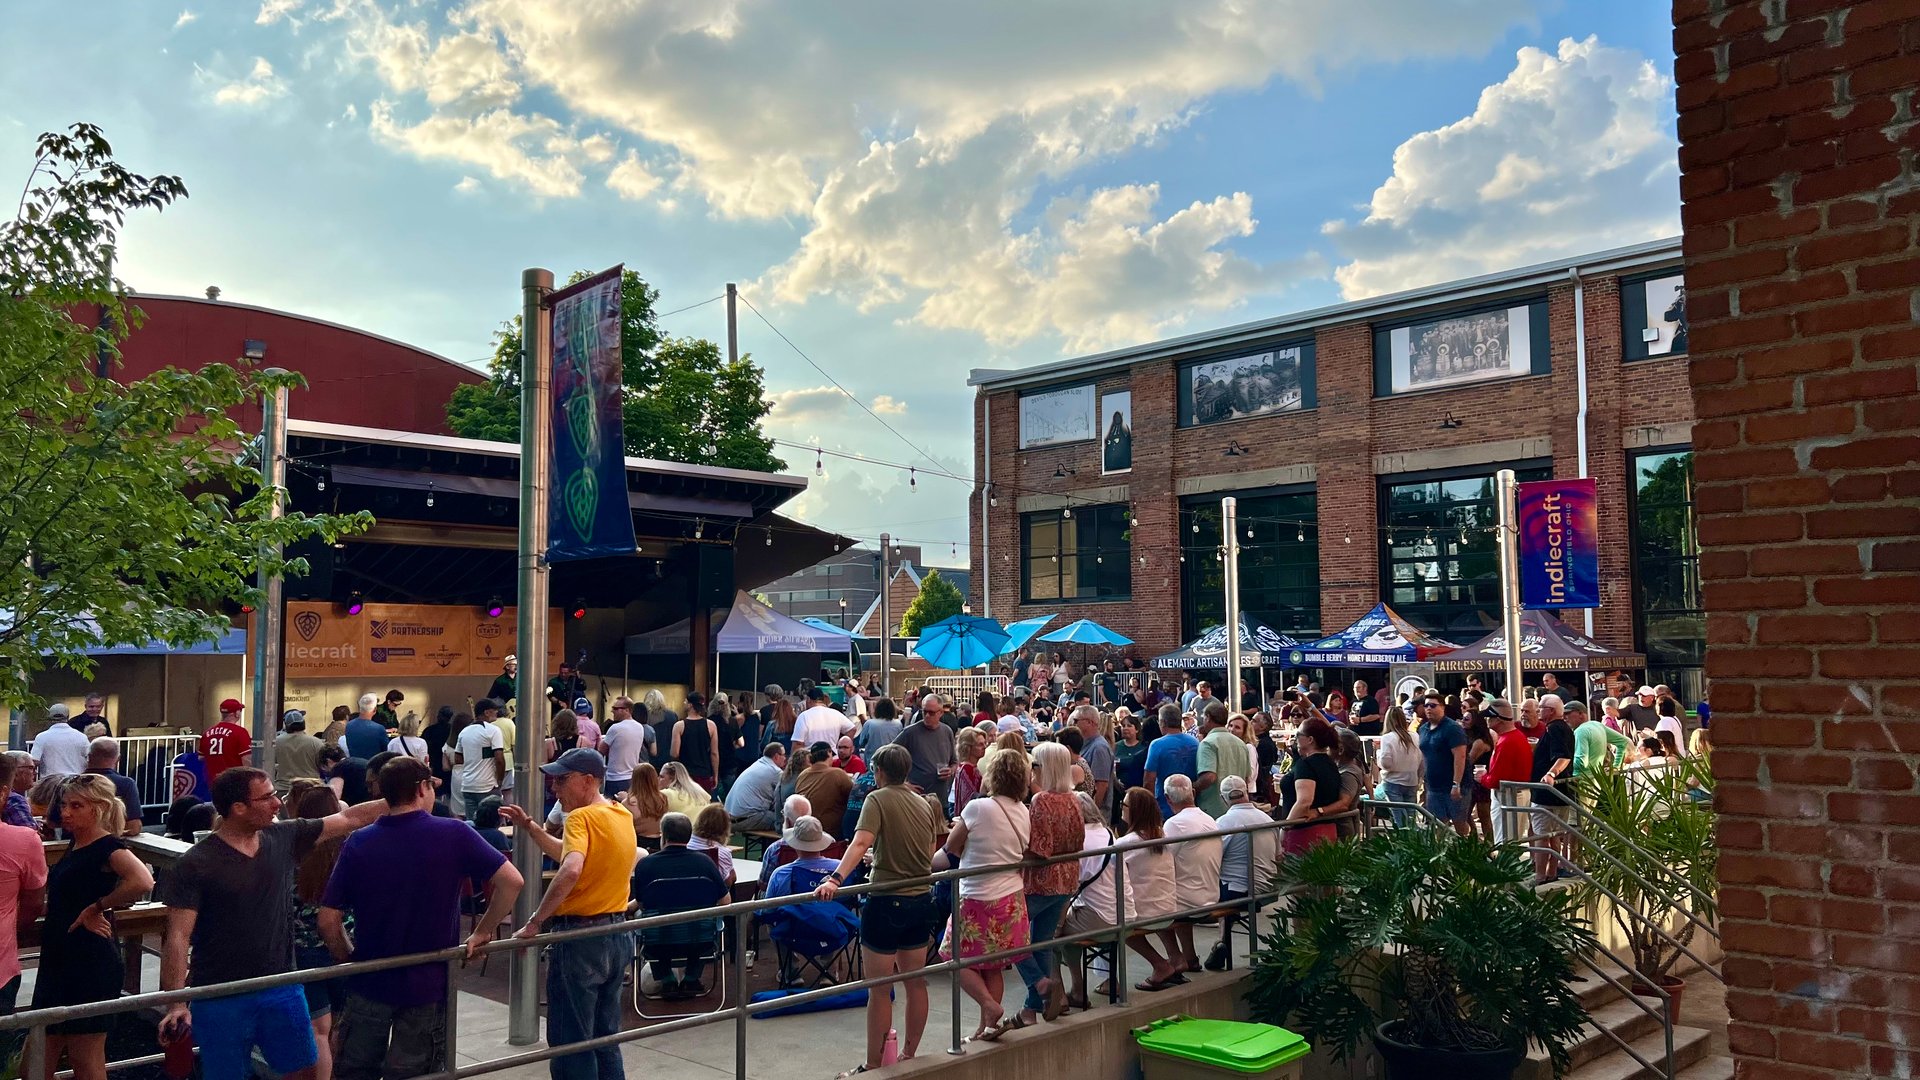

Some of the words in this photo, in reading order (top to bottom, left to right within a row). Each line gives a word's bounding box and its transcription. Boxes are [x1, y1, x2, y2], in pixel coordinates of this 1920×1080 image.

[1543, 493, 1565, 603] indiecraft
[391, 626, 444, 636] PARTNERSHIP
[1157, 657, 1195, 669] ALEMATIC
[1261, 656, 1280, 665] CRAFT
[1305, 653, 1325, 662] BUMBLE
[1326, 653, 1343, 662] BERRY
[1347, 653, 1365, 662] HONEY
[1365, 653, 1396, 663] BLUEBERRY
[1396, 654, 1407, 663] ALE
[1523, 658, 1581, 670] BREWERY
[206, 727, 233, 737] GREENE
[209, 737, 224, 755] 21
